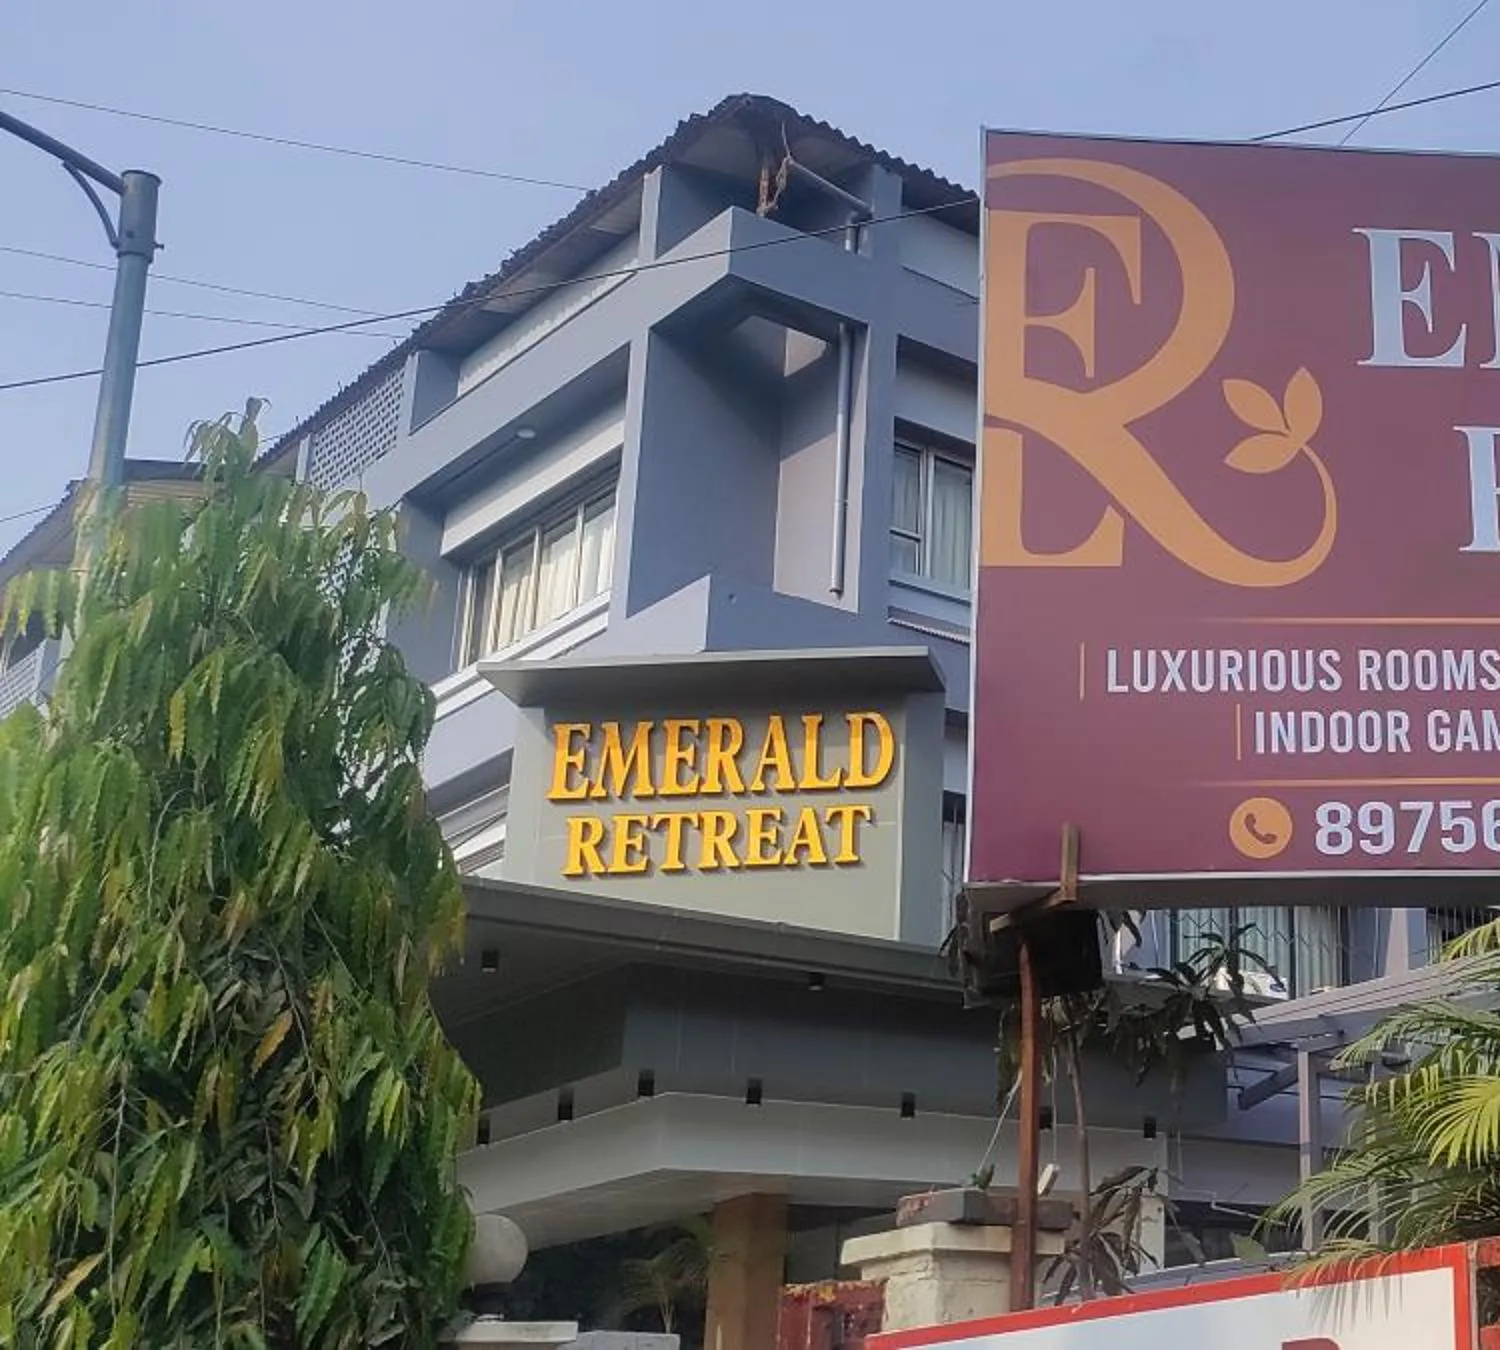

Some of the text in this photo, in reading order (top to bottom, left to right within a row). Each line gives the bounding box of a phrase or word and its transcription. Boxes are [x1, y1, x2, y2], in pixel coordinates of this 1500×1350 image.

[1106, 648, 1343, 693] LUXURIOUS
[546, 711, 896, 801] EMERALD
[1254, 709, 1411, 754] INDOOR
[561, 803, 872, 878] RETREAT
